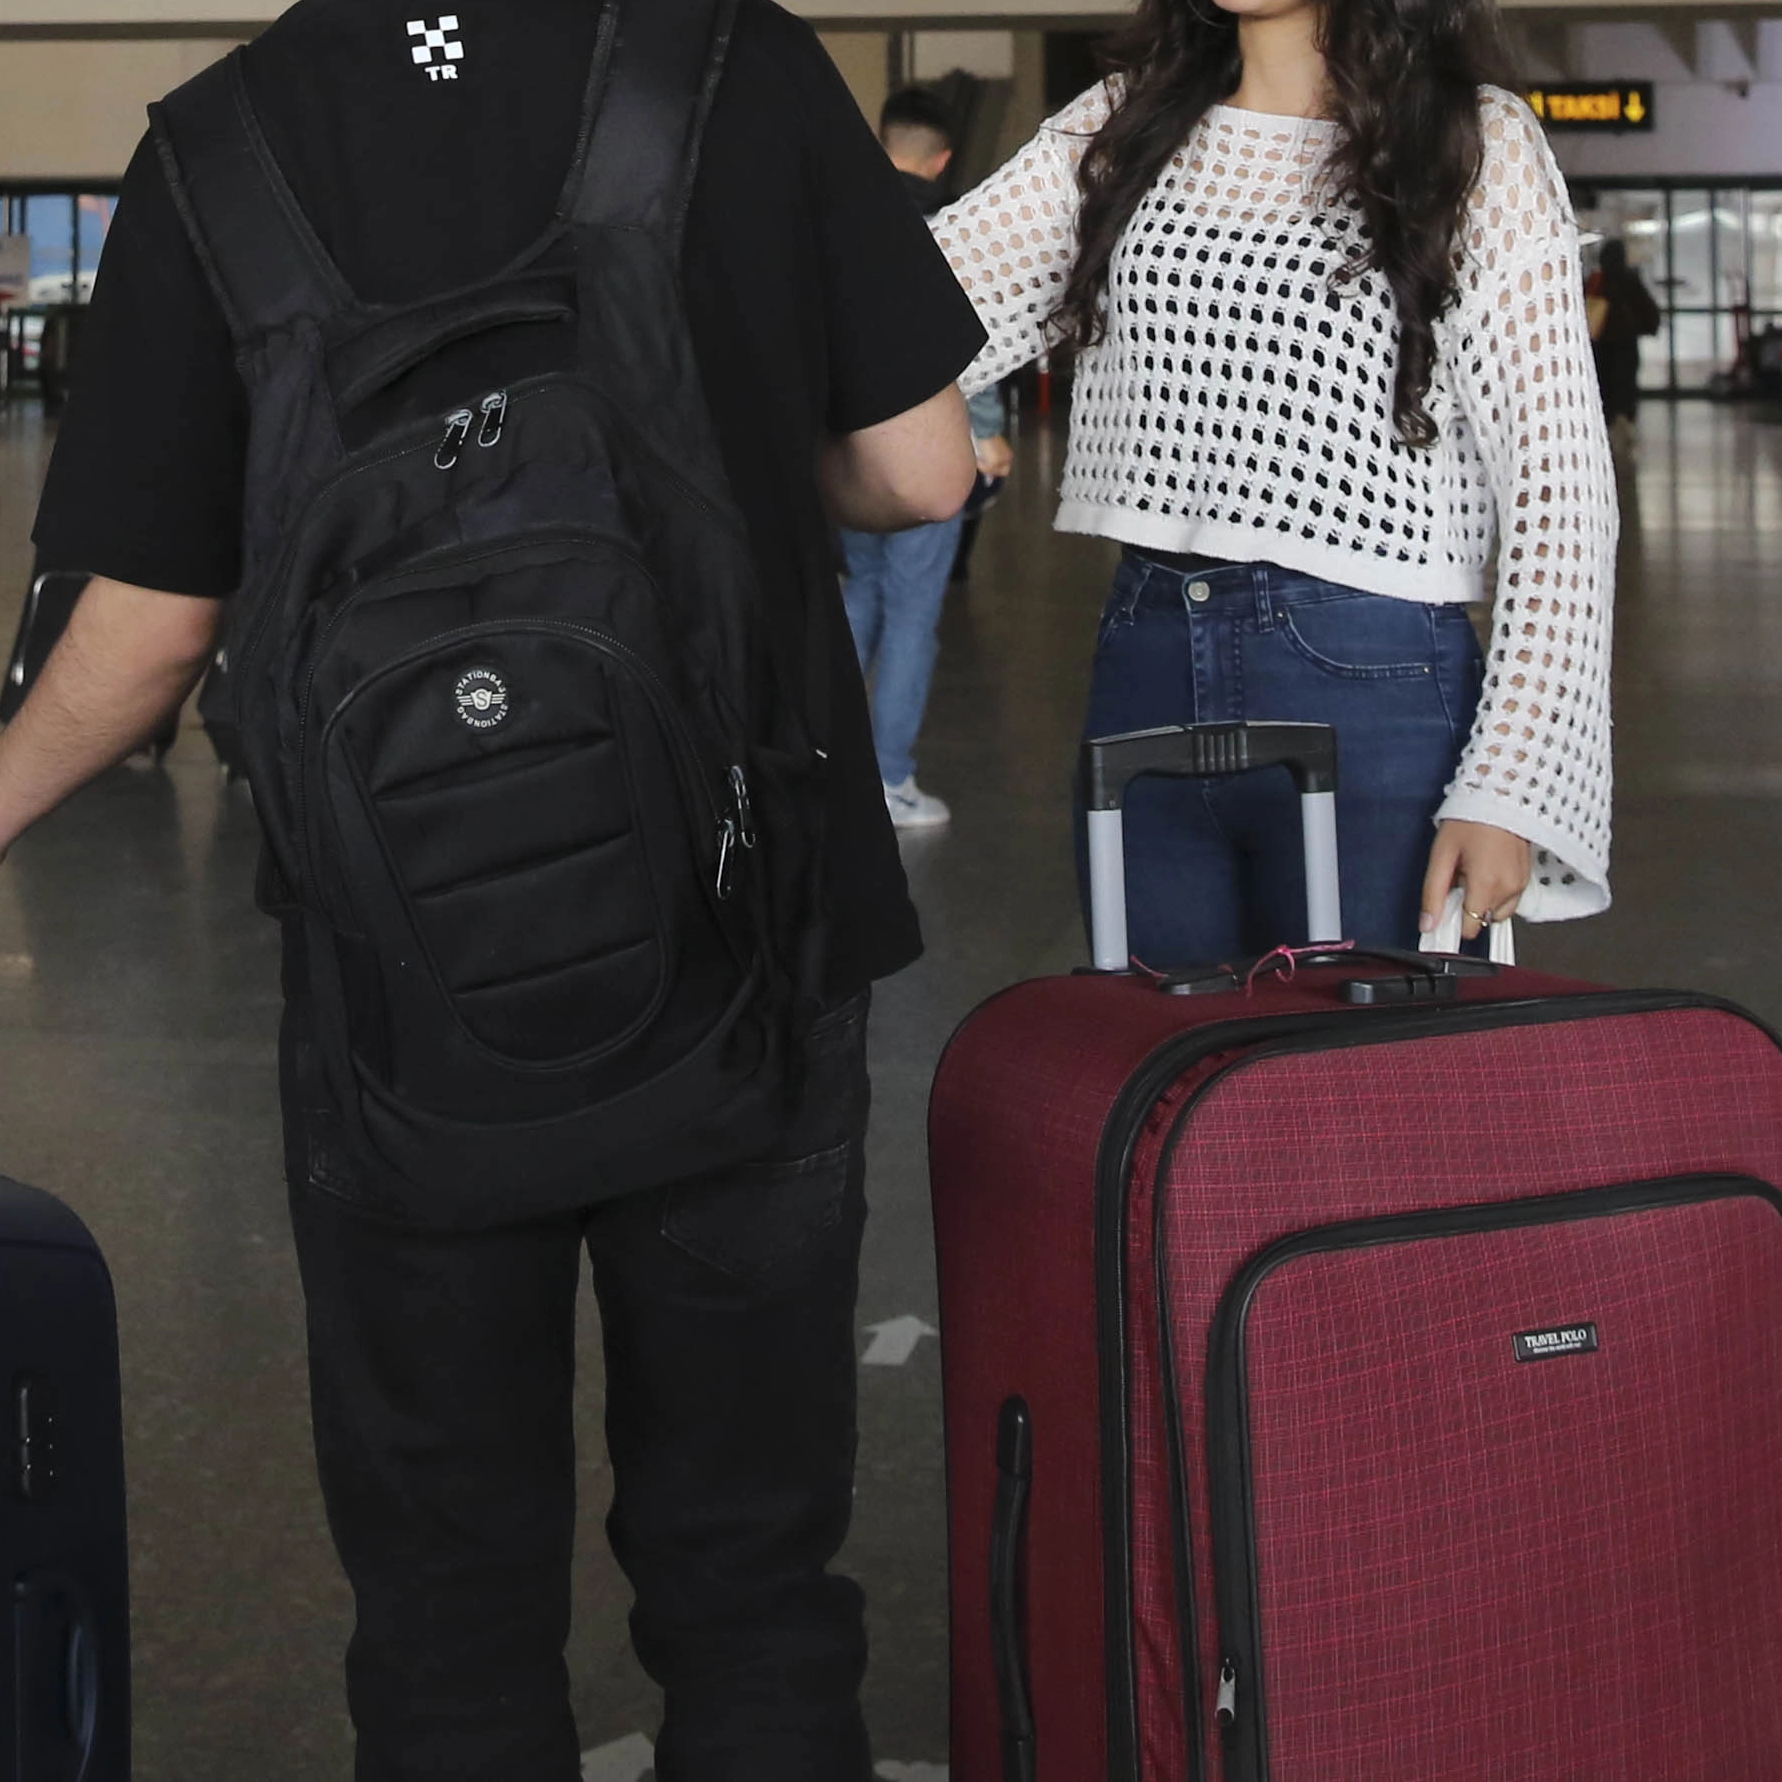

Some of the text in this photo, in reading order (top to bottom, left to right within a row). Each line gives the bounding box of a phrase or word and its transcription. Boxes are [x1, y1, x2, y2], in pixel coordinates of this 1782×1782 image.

[424, 64, 458, 82] TR
[1524, 1331, 1561, 1349] TRAVEL
[1561, 1328, 1588, 1343] POLO
